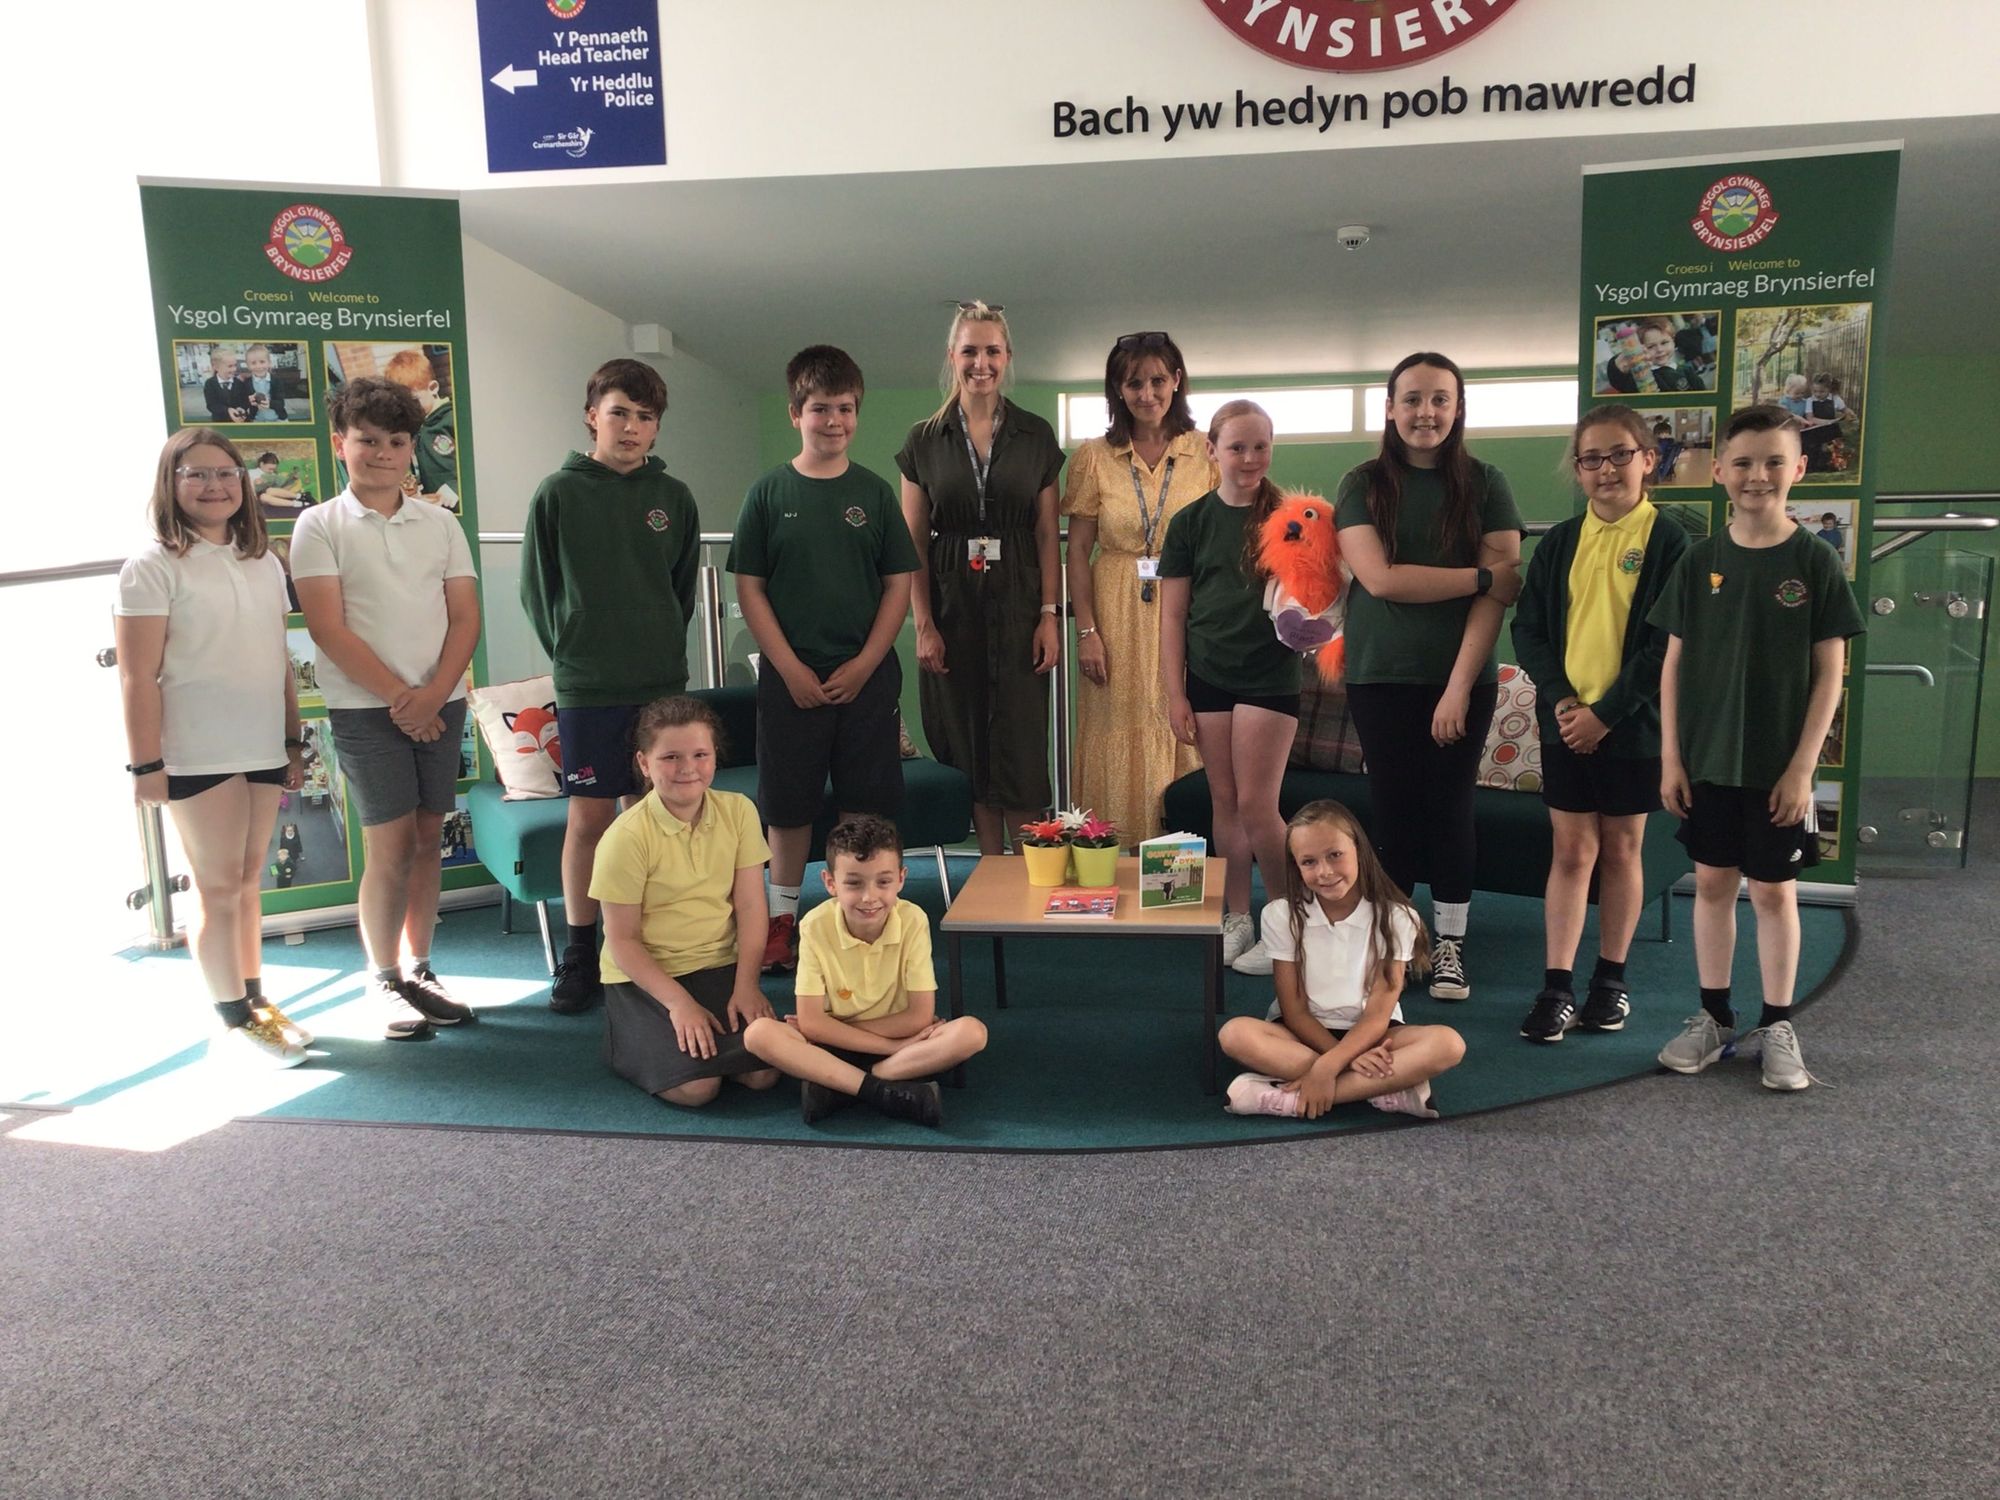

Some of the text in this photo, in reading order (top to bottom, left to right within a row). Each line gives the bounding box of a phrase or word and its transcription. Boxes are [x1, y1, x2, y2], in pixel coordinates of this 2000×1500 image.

[553, 26, 649, 48] Y Pennaeth
[538, 45, 650, 66] Head Teacher
[570, 72, 653, 92] Yr Heddlu
[604, 91, 655, 108] Police
[1052, 63, 1697, 142] Bach yw hedyn pob mawredd
[1700, 176, 1771, 212] YSGOL GYMRAEG
[272, 206, 343, 243] YSGOL GYMRAEG
[1692, 216, 1777, 252] BRYNSIERFEL
[266, 246, 352, 281] BRYNSIERFEL
[1665, 264, 1707, 276] Croeso
[1728, 257, 1801, 272] Welcome to
[243, 290, 288, 302] Croeso
[308, 290, 380, 304] Welcome to
[1595, 267, 1876, 305] Ysgol Gymraeg Brynsierfel
[168, 304, 451, 331] Ysgol Gymraeg Brynsierfel
